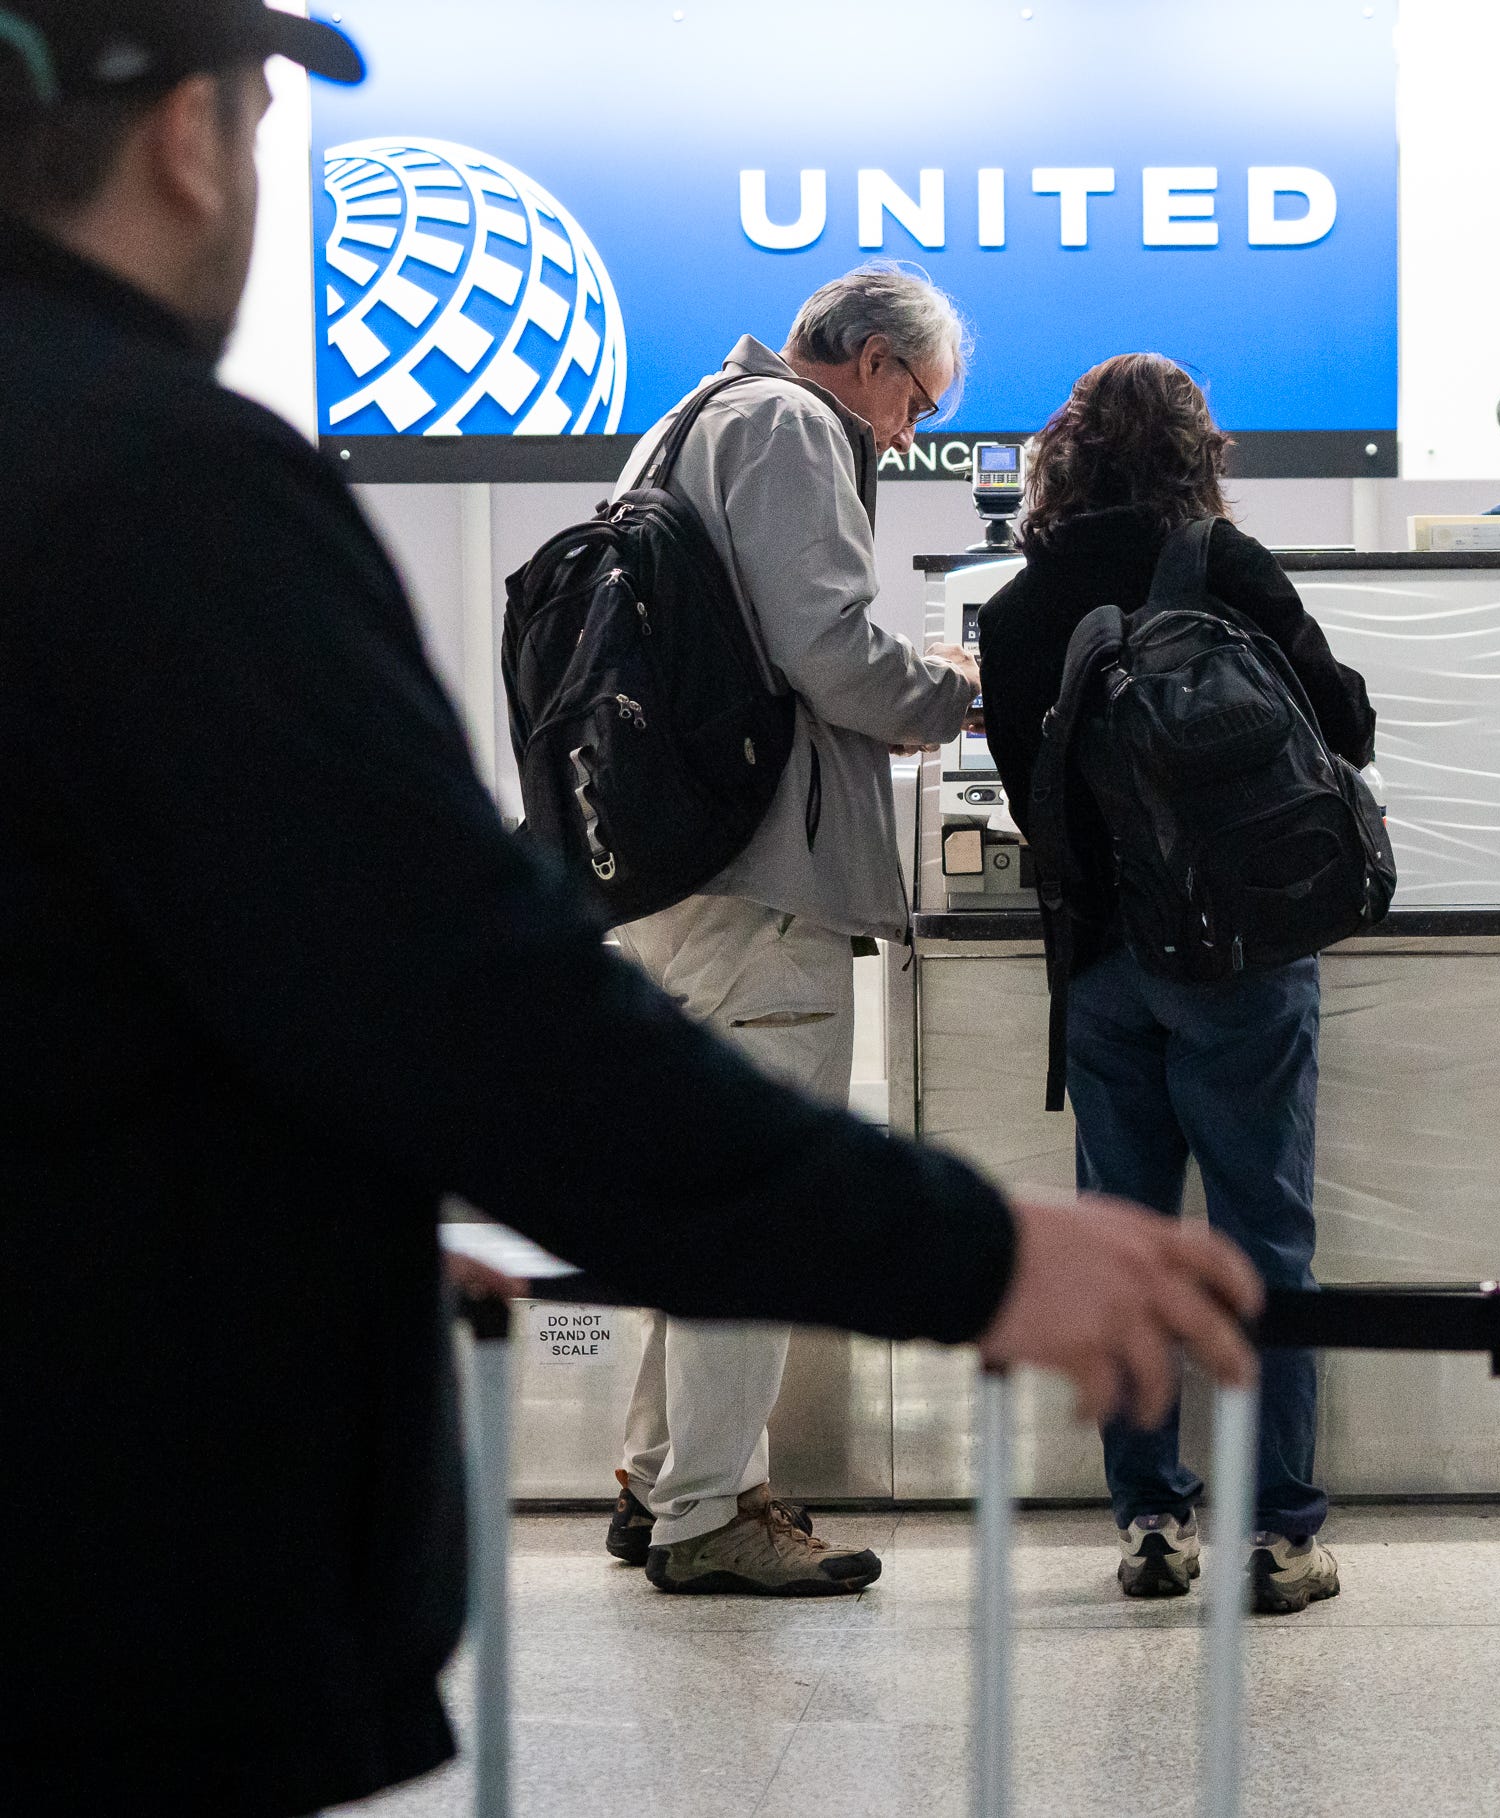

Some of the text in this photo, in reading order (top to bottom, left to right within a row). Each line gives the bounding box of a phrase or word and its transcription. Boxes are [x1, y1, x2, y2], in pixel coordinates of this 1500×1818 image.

[740, 166, 1338, 249] UNITED
[878, 441, 998, 473] ANC
[548, 1315, 602, 1327] DO NOT
[539, 1329, 611, 1342] STAND ON
[551, 1344, 599, 1356] SCALE
